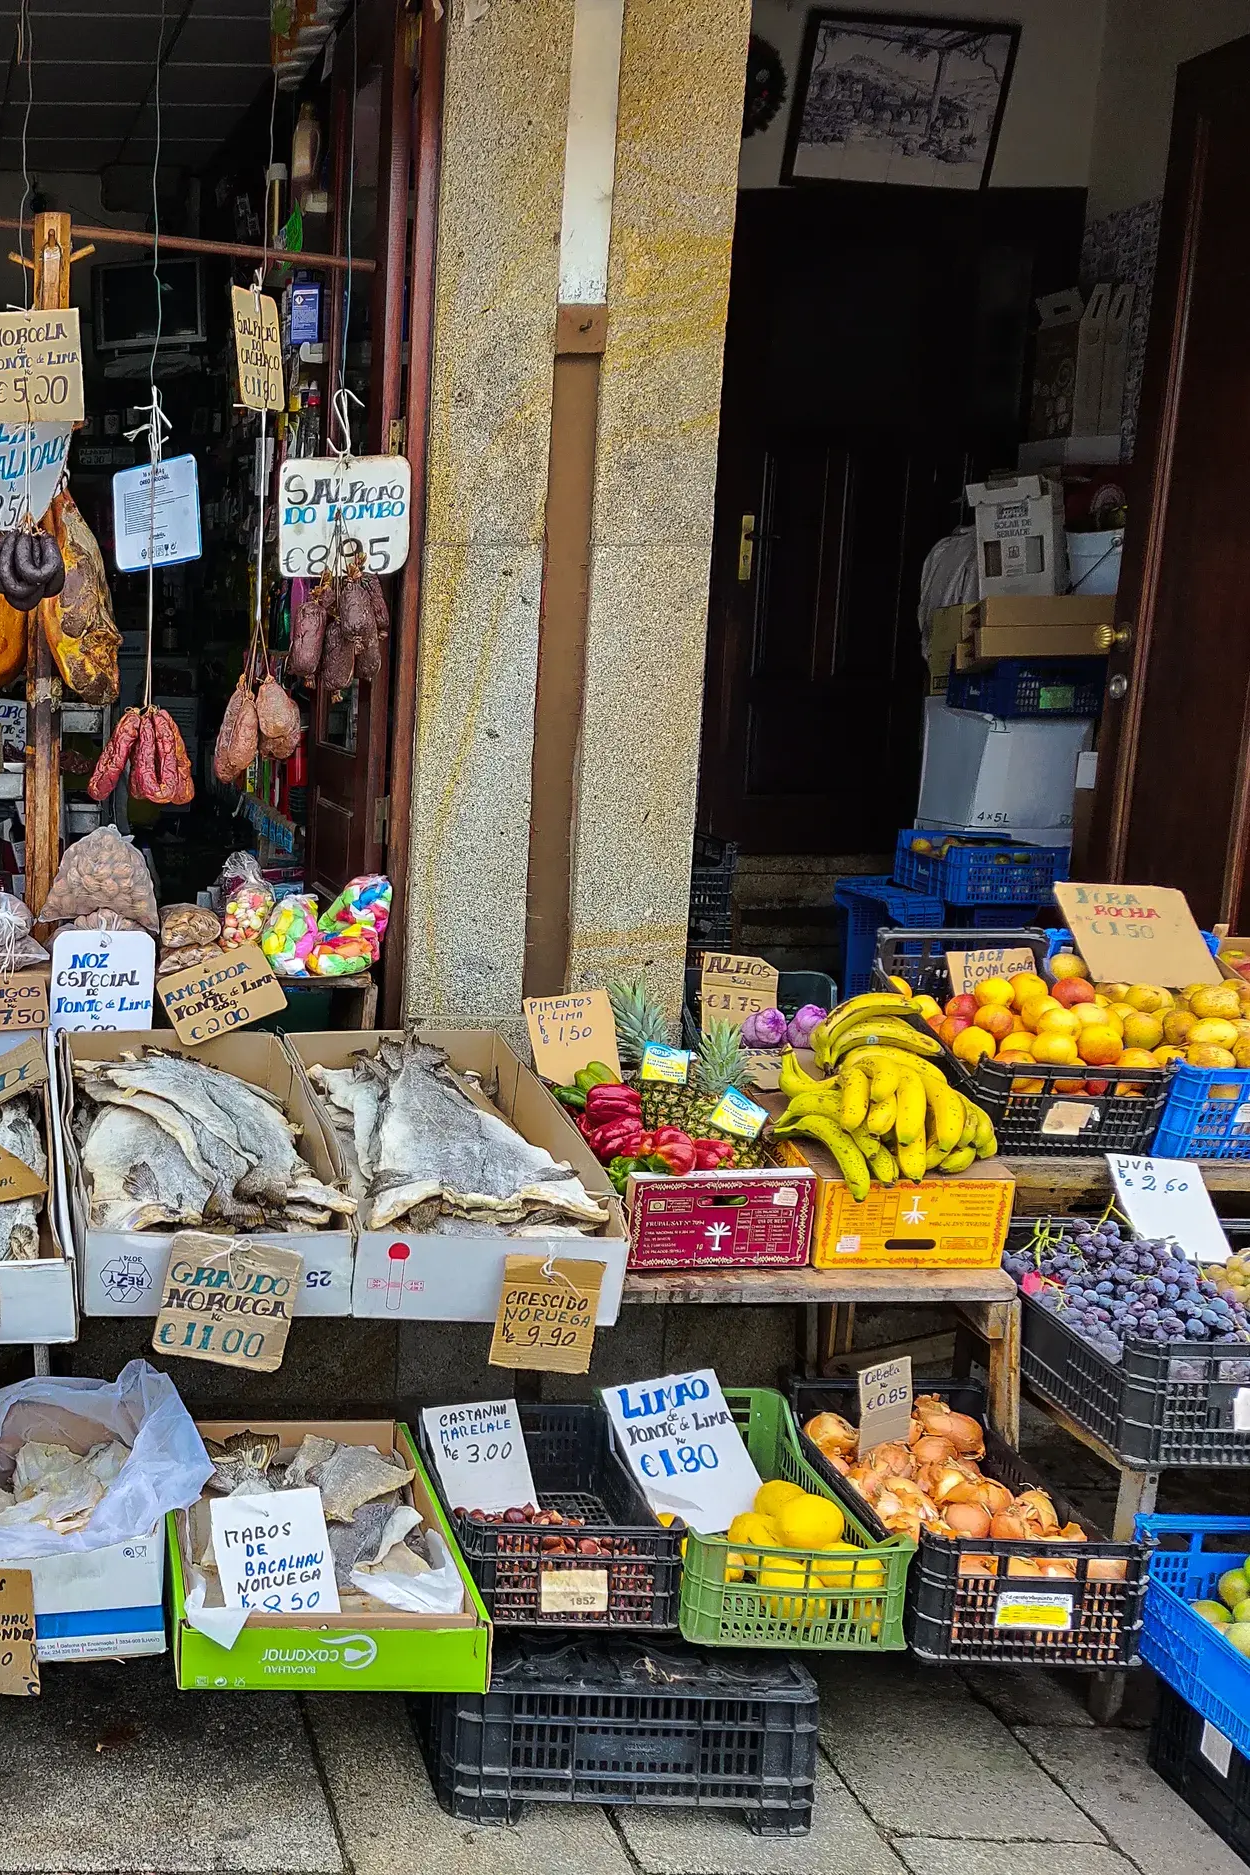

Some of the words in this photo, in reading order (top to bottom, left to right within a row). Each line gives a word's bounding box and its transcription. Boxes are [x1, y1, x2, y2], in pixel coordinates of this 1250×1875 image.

[17, 344, 26, 354] de
[47, 351, 79, 366] LIMA
[283, 507, 316, 525] DO
[327, 501, 405, 521] LOMBO
[1094, 906, 1160, 919] ROCHA
[68, 953, 109, 969] NOZ
[706, 956, 771, 978] ALHOS
[56, 970, 140, 987] ESPECIAL
[240, 974, 277, 994] LIMA
[86, 988, 99, 996] DE
[54, 998, 102, 1014] PONTE
[118, 997, 152, 1011] LIMA
[529, 997, 592, 1015] PIMENTOS
[1116, 1159, 1154, 1171] UVA
[123, 1255, 144, 1264] 3074
[306, 1270, 332, 1288] 25
[161, 1287, 287, 1319] NORUEGA
[505, 1290, 588, 1312] CRESCIDO
[504, 1306, 591, 1329] NORUEGA
[864, 1365, 900, 1386] Cebola
[438, 1404, 508, 1427] CASTANHA
[666, 1408, 680, 1422] de
[695, 1410, 735, 1431] LIMA
[224, 1521, 292, 1548] RABOS
[245, 1544, 269, 1557] DE
[244, 1551, 324, 1578] BACALHAU
[237, 1568, 322, 1594] NORUEGA
[569, 1595, 597, 1606] 1852
[263, 1665, 317, 1674] BACALHAU
